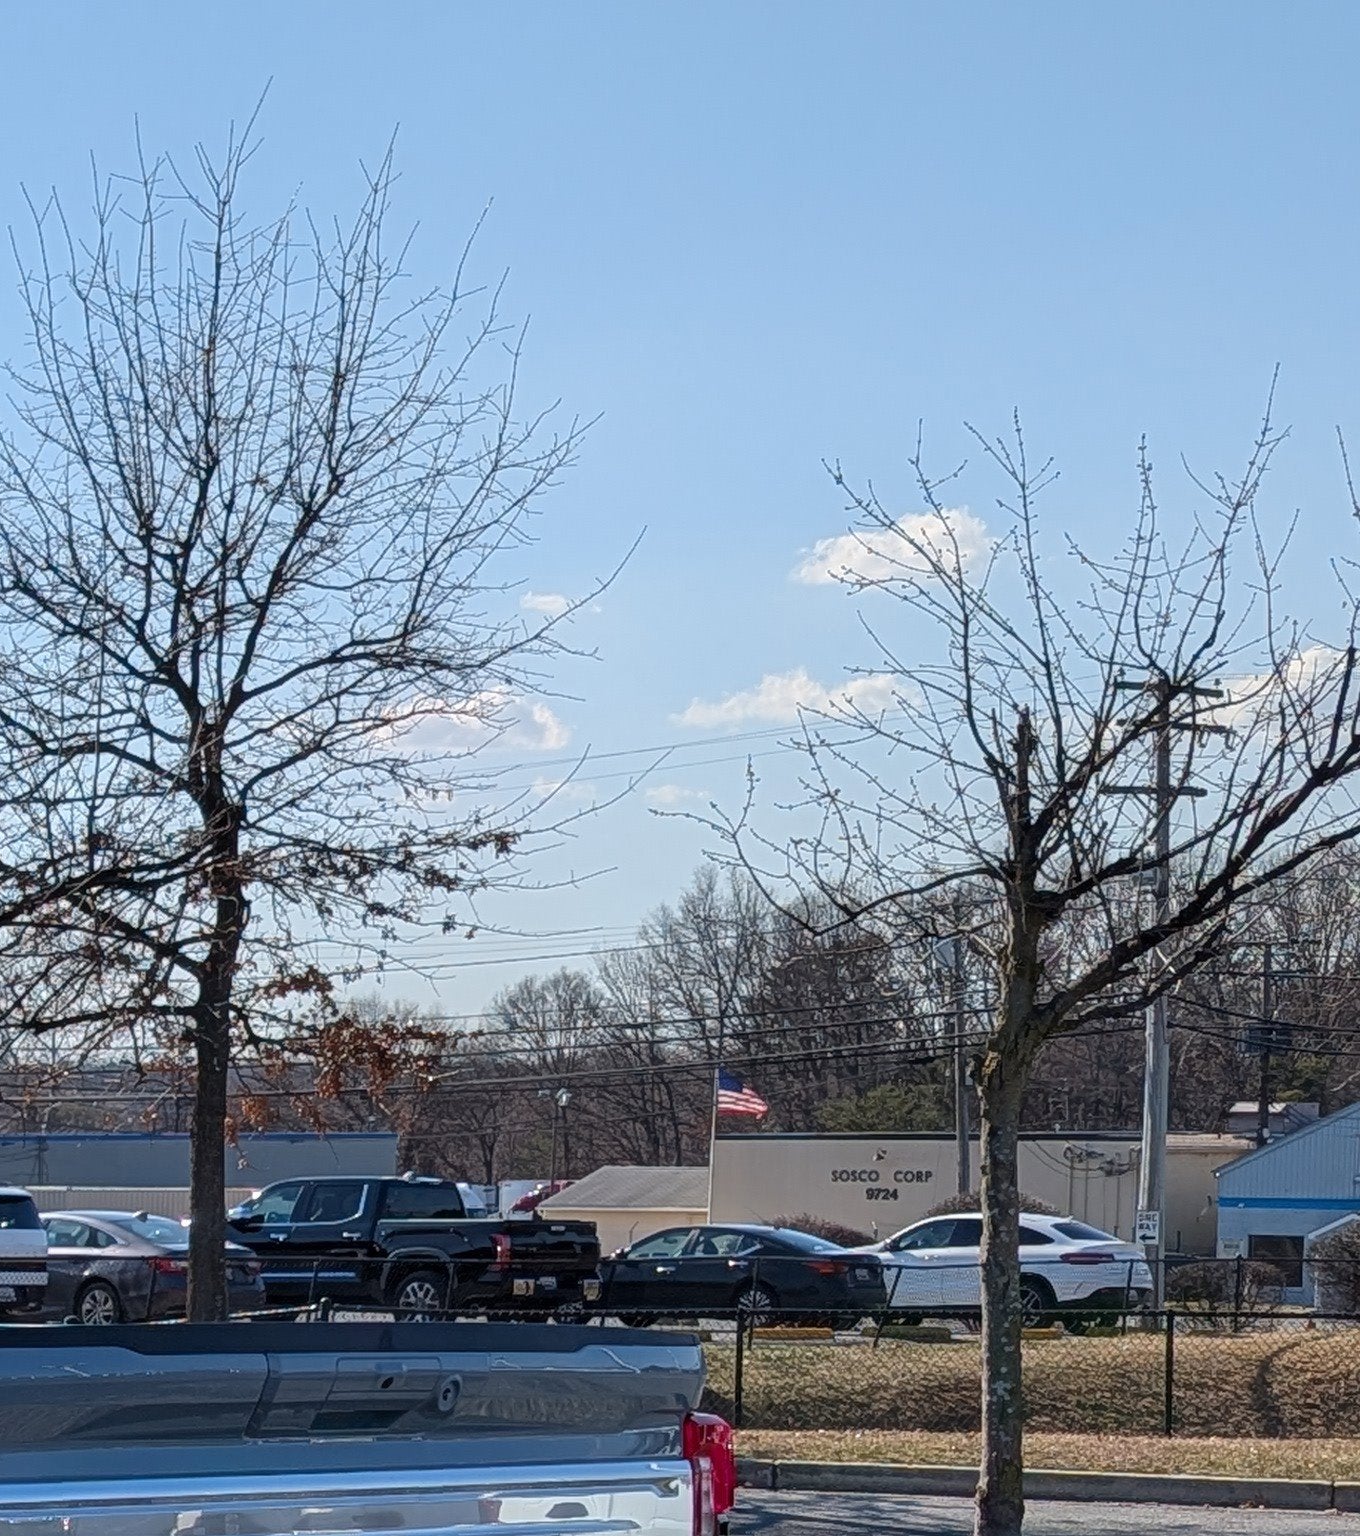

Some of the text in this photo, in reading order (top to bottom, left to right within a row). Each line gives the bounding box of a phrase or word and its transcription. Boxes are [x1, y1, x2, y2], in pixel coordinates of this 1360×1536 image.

[831, 1169, 933, 1182] SOSCO CORP
[865, 1188, 899, 1200] 9724
[1138, 1223, 1158, 1232] WAY
